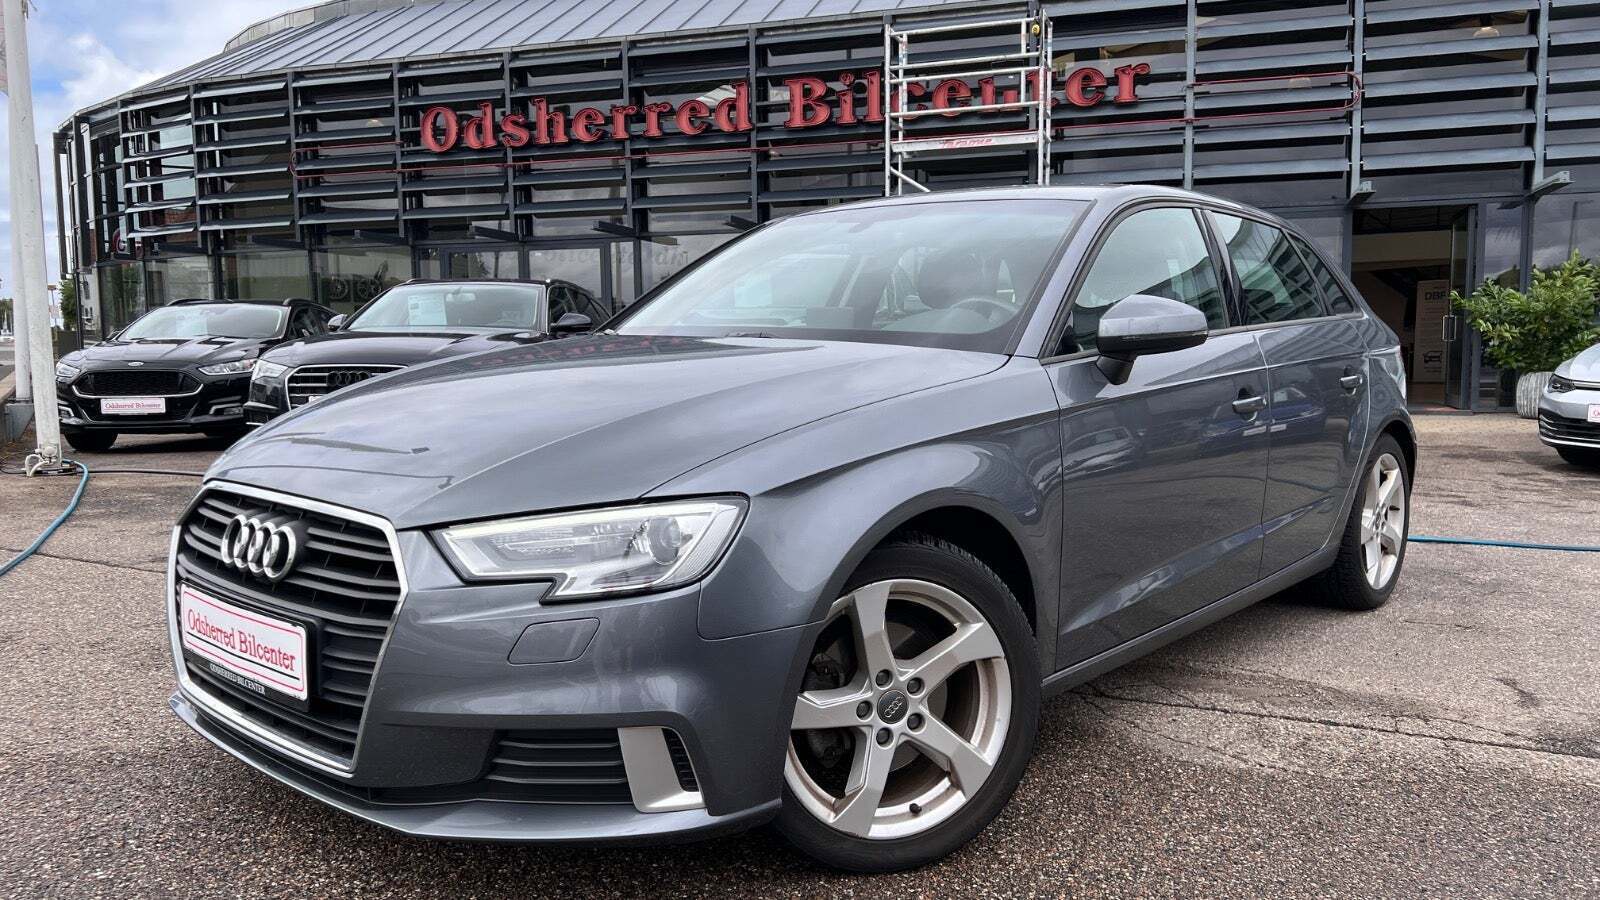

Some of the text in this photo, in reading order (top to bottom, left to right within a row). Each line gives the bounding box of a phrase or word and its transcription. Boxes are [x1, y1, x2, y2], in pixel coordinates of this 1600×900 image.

[420, 80, 753, 152] Odsherred
[188, 609, 296, 671] Odsherred Bilcenter
[237, 677, 265, 694] BILCENTER
